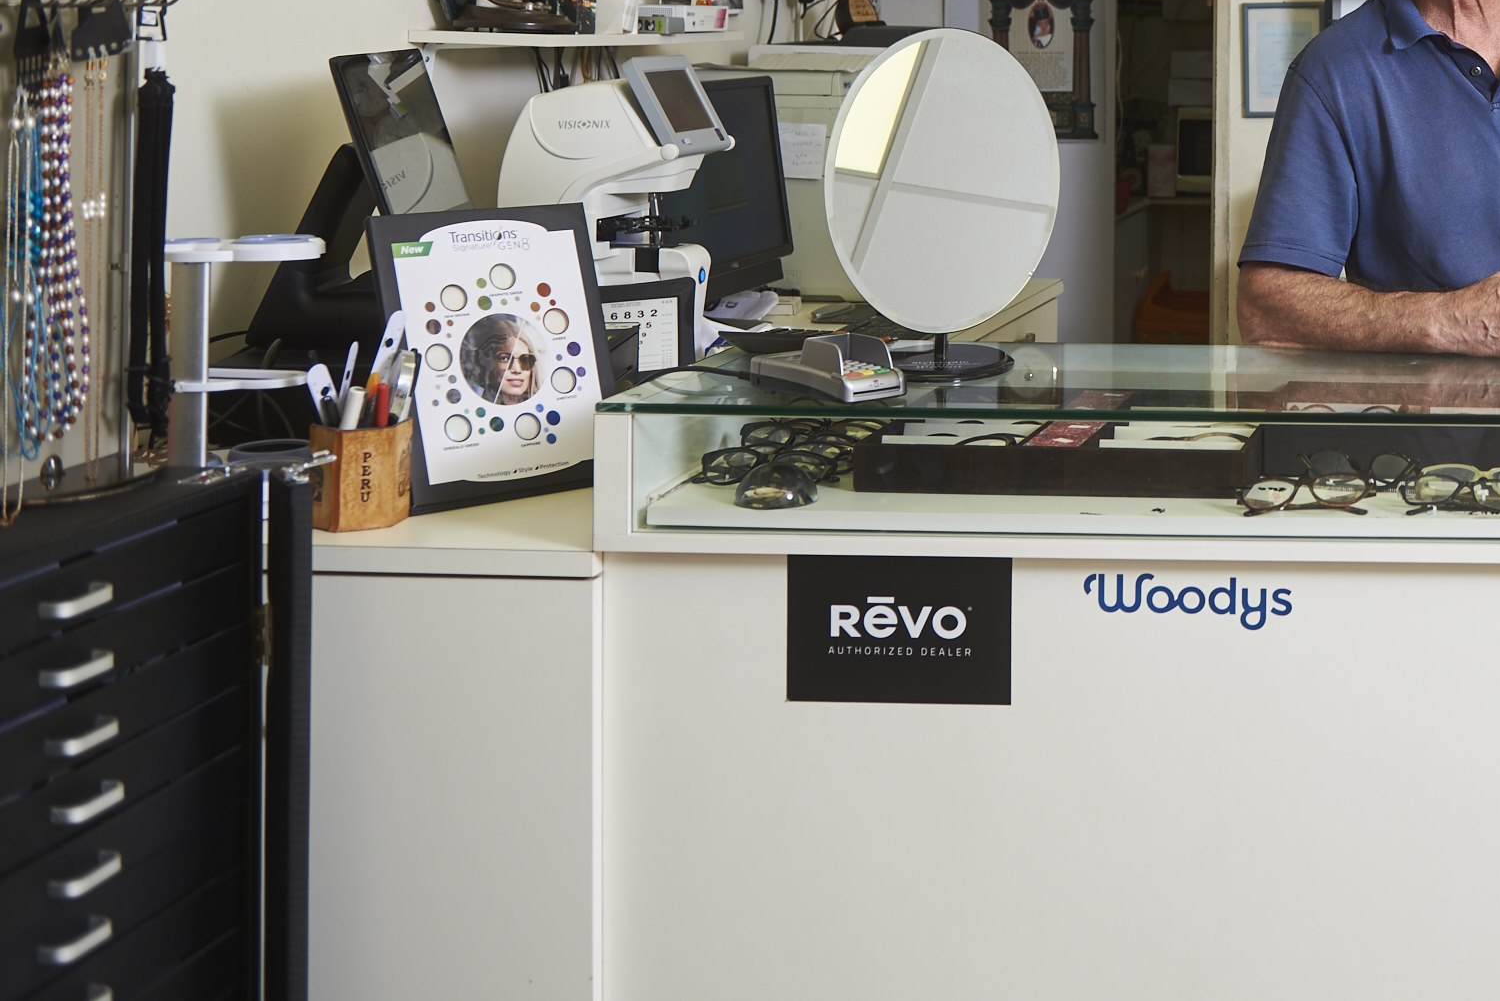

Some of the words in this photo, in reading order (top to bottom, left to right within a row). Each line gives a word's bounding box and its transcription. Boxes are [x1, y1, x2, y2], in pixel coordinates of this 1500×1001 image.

[449, 228, 518, 244] Transitions
[400, 244, 425, 255] New
[624, 311, 631, 319] 8
[637, 310, 644, 318] 3
[650, 309, 657, 317] 2
[360, 452, 372, 502] PERU
[477, 469, 511, 480] Technology
[518, 466, 533, 475] Style
[539, 460, 570, 471] Protection
[1083, 573, 1293, 631] Woodys
[828, 646, 914, 656] AUTHORIZED
[920, 647, 972, 657] DEALER
